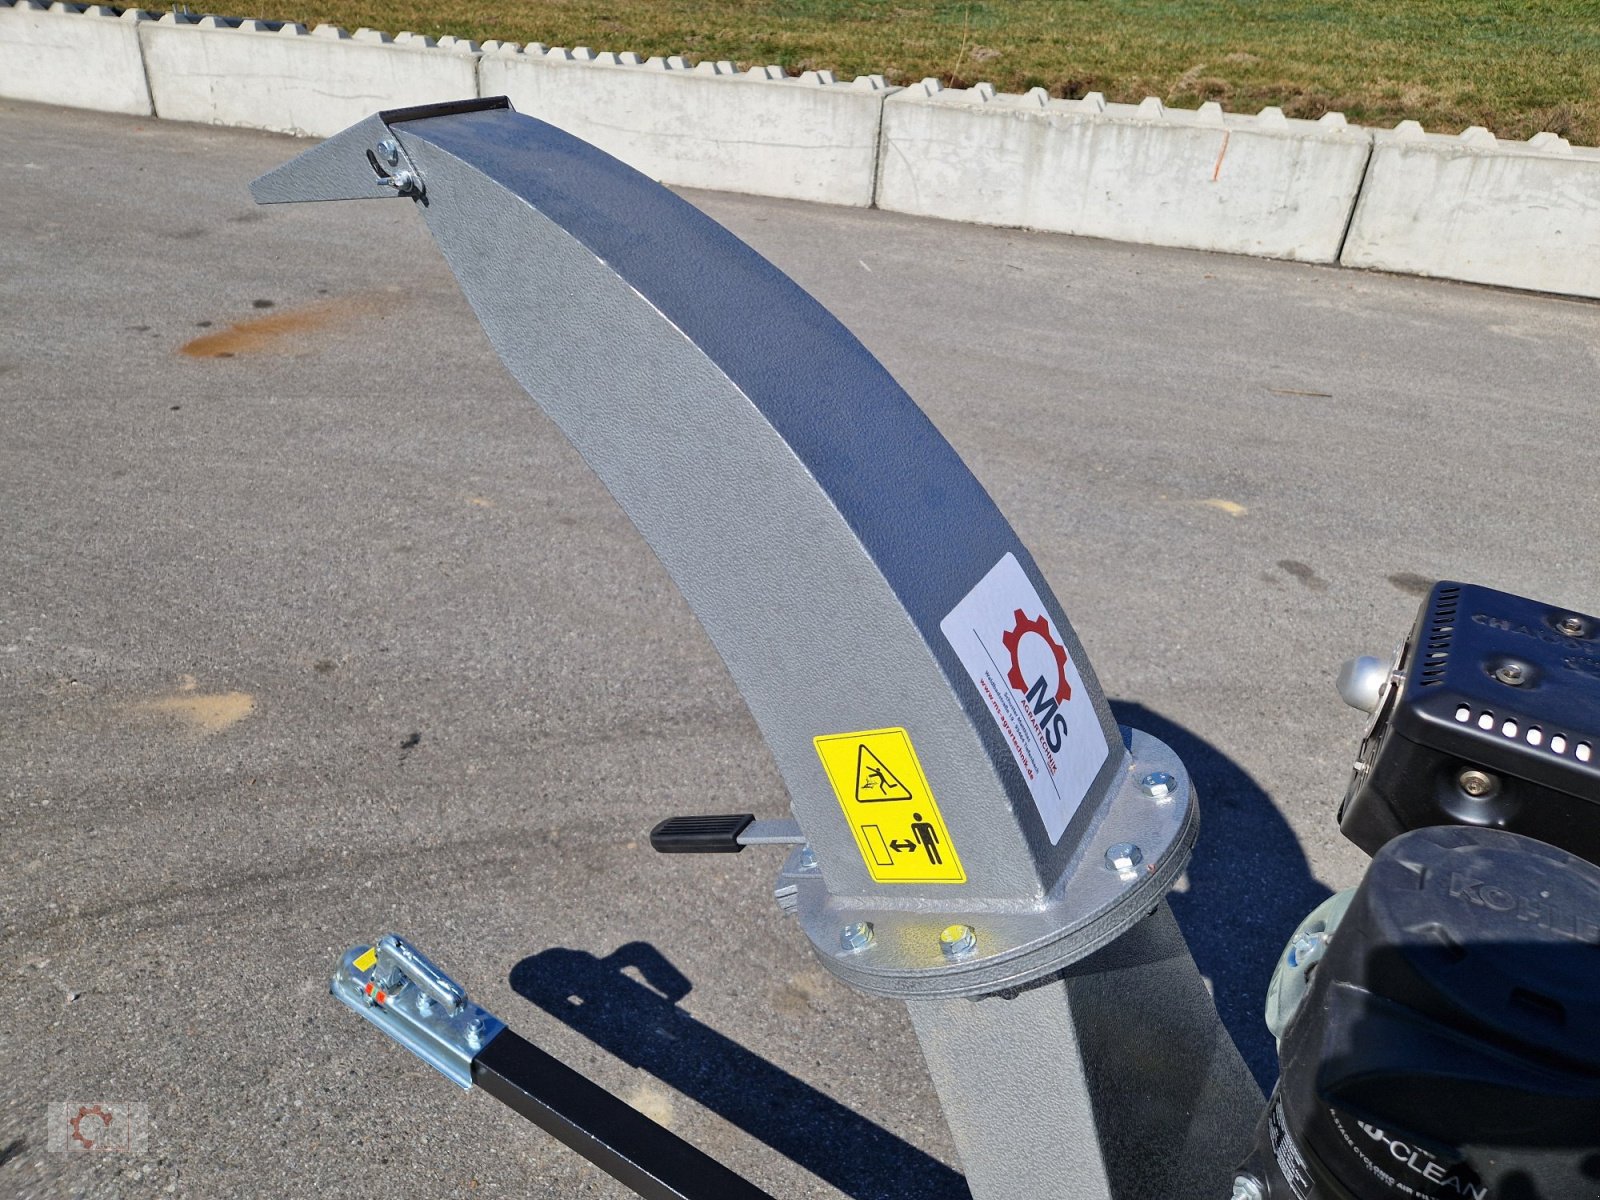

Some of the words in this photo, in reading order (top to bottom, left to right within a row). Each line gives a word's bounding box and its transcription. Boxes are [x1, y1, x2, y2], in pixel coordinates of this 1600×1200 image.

[980, 678, 1034, 781] www.ms-agrartechnik.de
[1021, 699, 1057, 772] AGRARTECHNIK
[1026, 675, 1068, 753] MS
[1449, 871, 1600, 942] KOHLE
